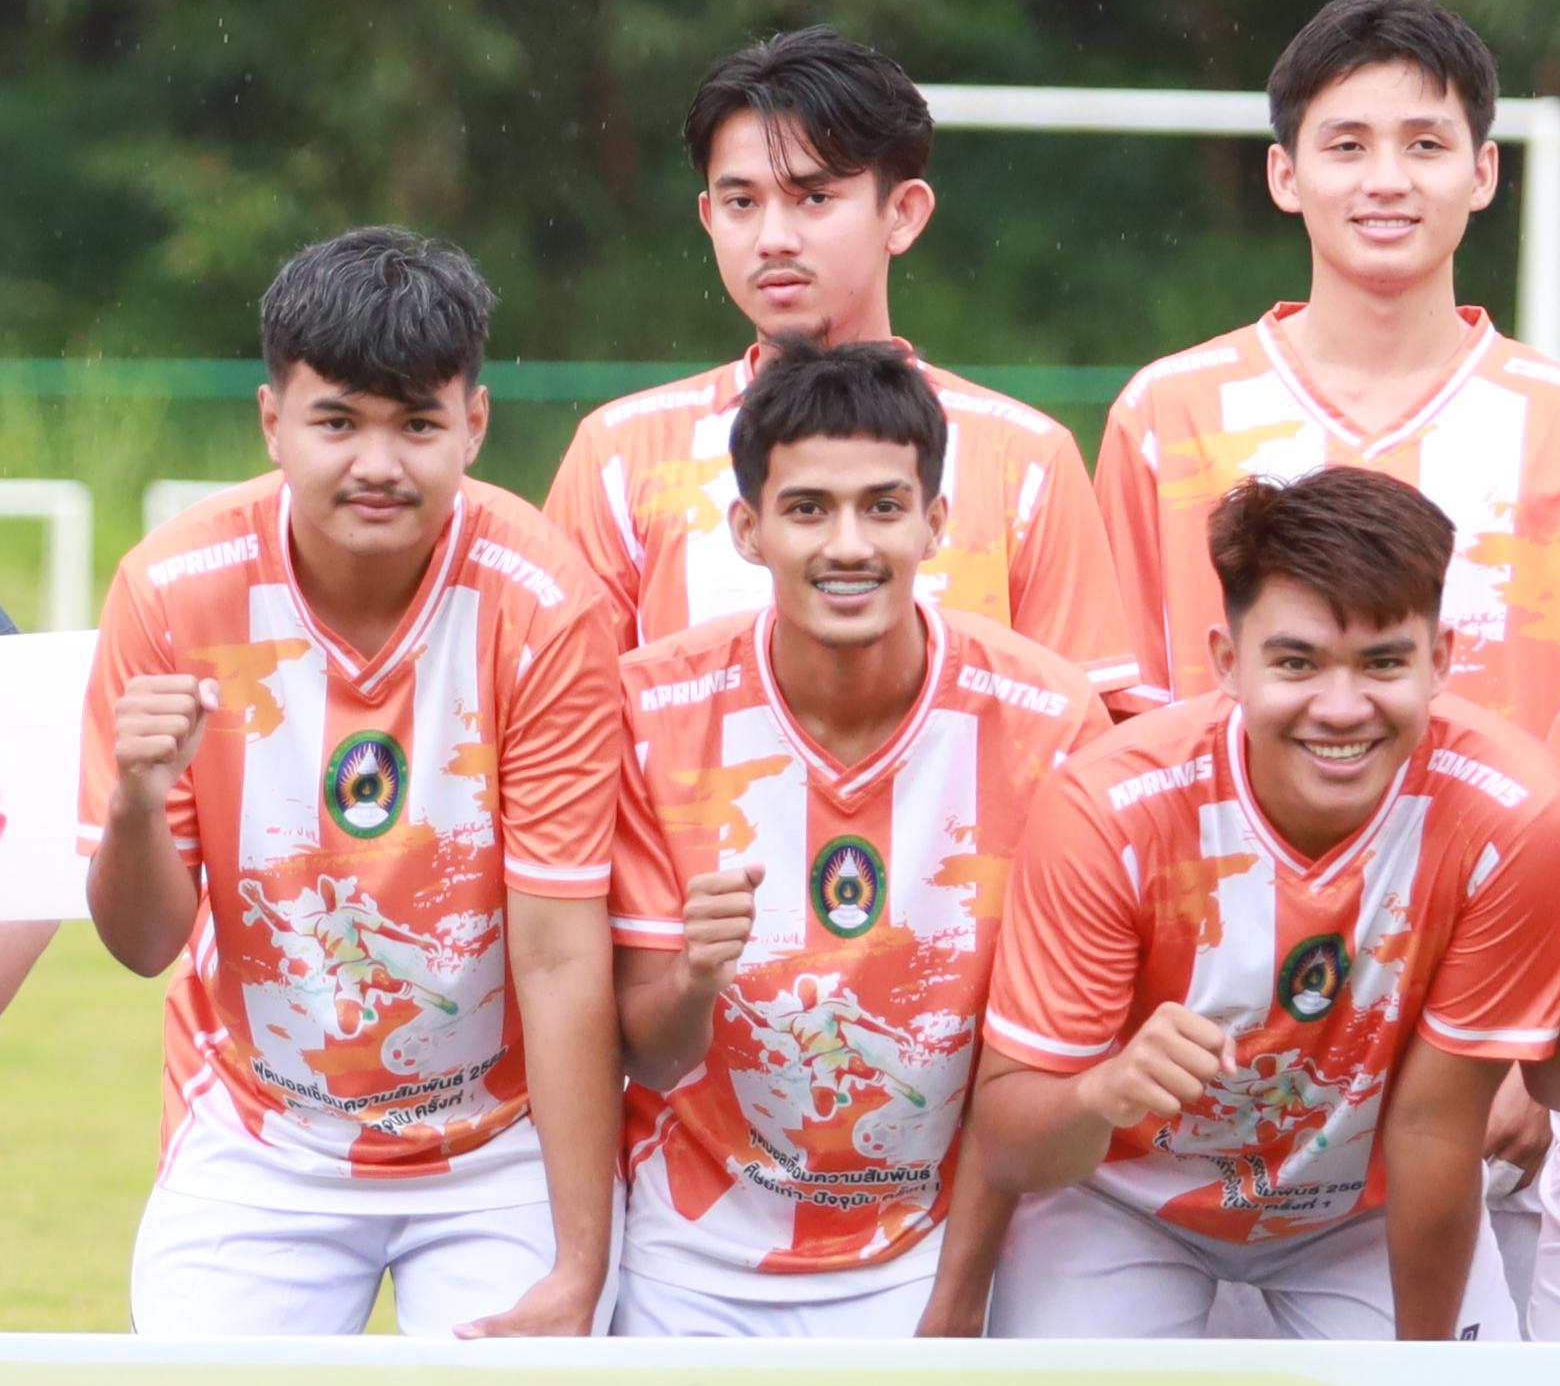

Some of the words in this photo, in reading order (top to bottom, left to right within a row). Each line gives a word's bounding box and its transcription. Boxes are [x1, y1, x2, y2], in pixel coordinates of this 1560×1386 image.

[146, 533, 259, 587] KPRUMS
[641, 664, 741, 712] KPRUMS
[957, 664, 1069, 717] COMTMS
[1427, 748, 1531, 809] COMTMS
